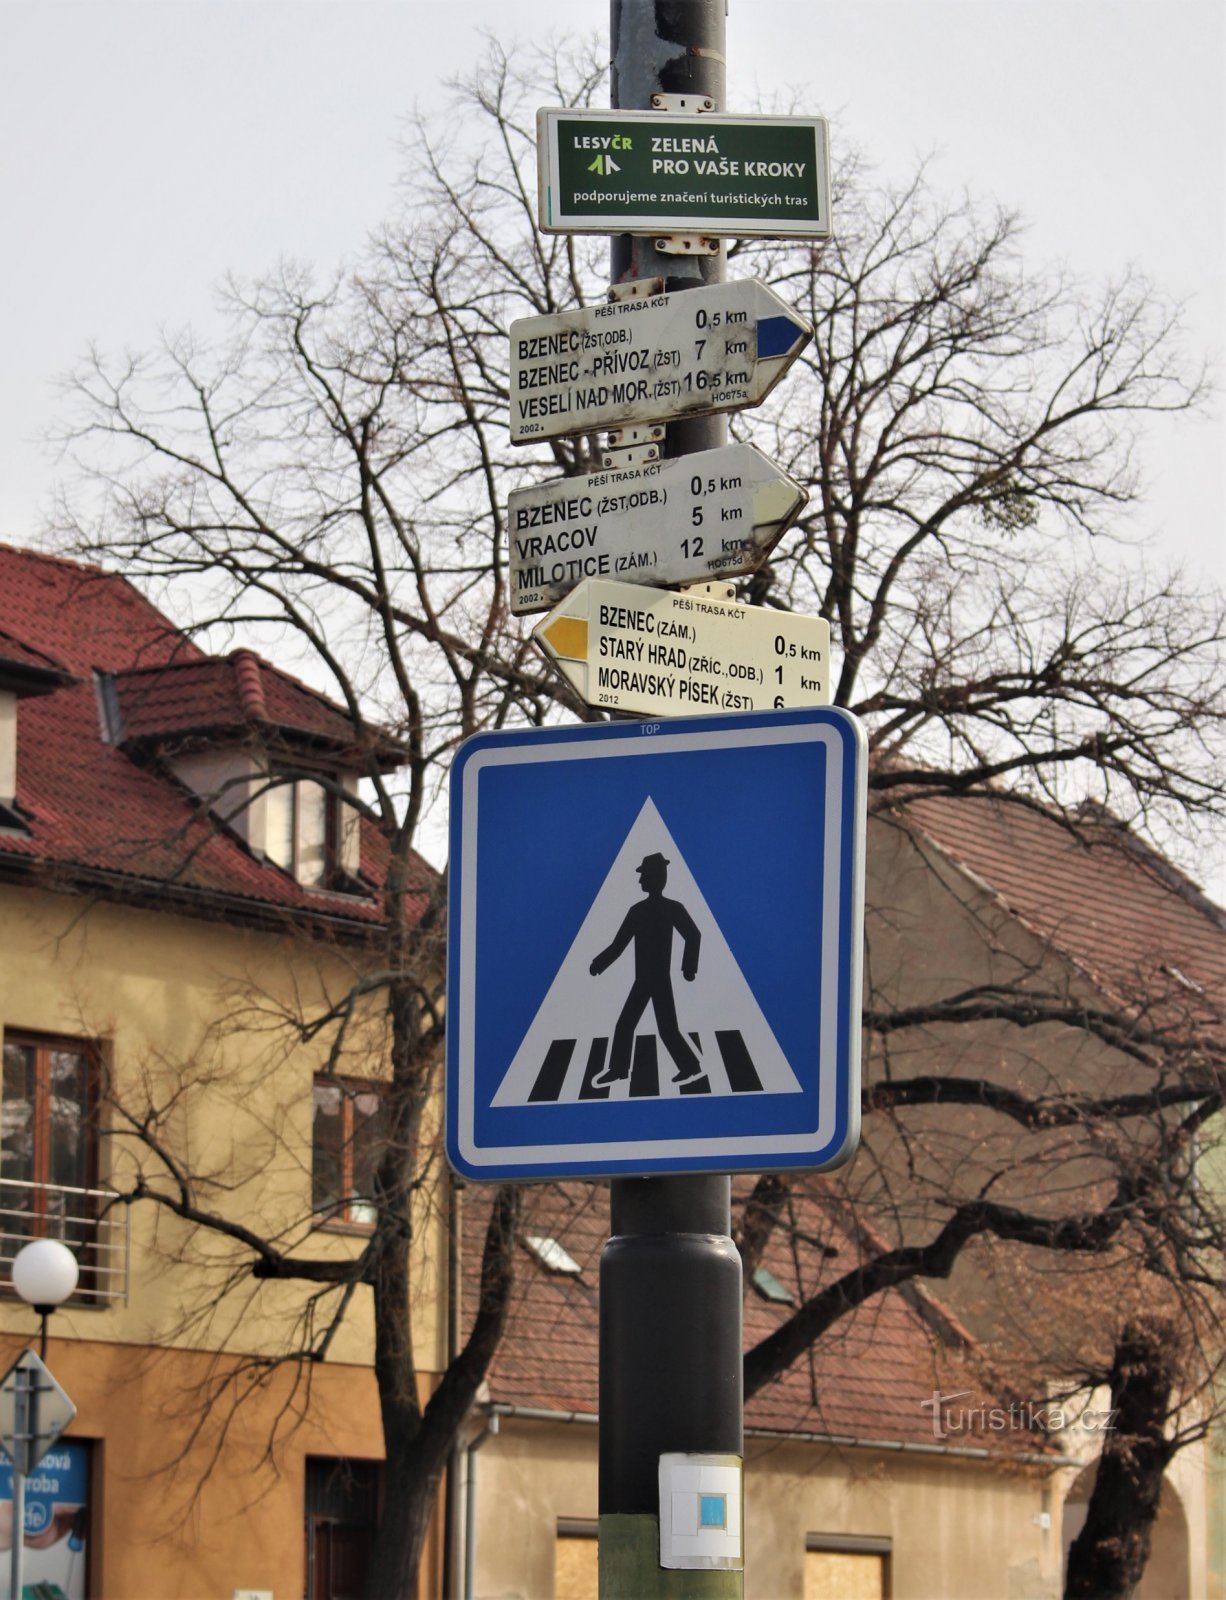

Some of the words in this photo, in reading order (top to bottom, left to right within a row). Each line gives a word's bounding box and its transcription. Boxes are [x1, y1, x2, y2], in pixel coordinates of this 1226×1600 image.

[651, 135, 719, 154] ZELENÁ
[652, 159, 689, 175] PRO
[694, 157, 739, 176] VAŠE
[744, 161, 806, 178] KROKY
[573, 190, 657, 205] podporujeme
[660, 190, 707, 203] značení
[711, 191, 782, 206] turistických
[785, 194, 808, 206] tras
[595, 306, 617, 318] PĚŠÍ
[618, 302, 649, 315] TRASA
[651, 296, 669, 310] KČT
[519, 331, 579, 360] BZENEC
[696, 309, 721, 330] 0,5
[726, 309, 747, 324] km
[519, 362, 579, 389] BZENEC
[594, 349, 649, 377] PŘÍVOZ
[654, 350, 680, 369] (ŽST)
[695, 340, 706, 361] 7
[725, 341, 747, 355] km
[519, 387, 571, 419] VESELÍ
[576, 387, 608, 410] NAD
[654, 379, 681, 401] (ŽST)
[684, 370, 721, 392] 16,5
[725, 371, 748, 385] km
[588, 475, 609, 488] PĚŠÍ
[611, 470, 642, 485] TRASA
[643, 465, 662, 478] KČT
[516, 497, 592, 530] BZENEC
[690, 476, 716, 497] 0,5
[720, 476, 742, 491] km
[516, 526, 598, 560] VRACOV
[692, 506, 704, 527] 5
[721, 507, 743, 522] km
[518, 554, 610, 590] MILOTICE
[615, 551, 657, 573] (ZÁM.)
[681, 537, 704, 559] 12
[722, 538, 743, 552] km
[673, 599, 694, 611] PĚŠÍ
[696, 603, 726, 616] TRASA
[727, 609, 746, 620] KČT
[600, 605, 655, 633] BZENEC
[657, 619, 696, 644] (ZÁM.)
[774, 635, 797, 659] 0,5
[801, 646, 821, 661] km
[600, 636, 644, 662] STARÝ
[649, 643, 687, 669] HRAD
[774, 665, 784, 685] 1
[801, 676, 821, 692] km
[599, 667, 675, 698] MORAVSKÝ
[680, 677, 719, 706] PÍSEK
[722, 691, 754, 711] (ŽST)
[599, 693, 619, 705] 2012
[640, 724, 660, 736] TOP
